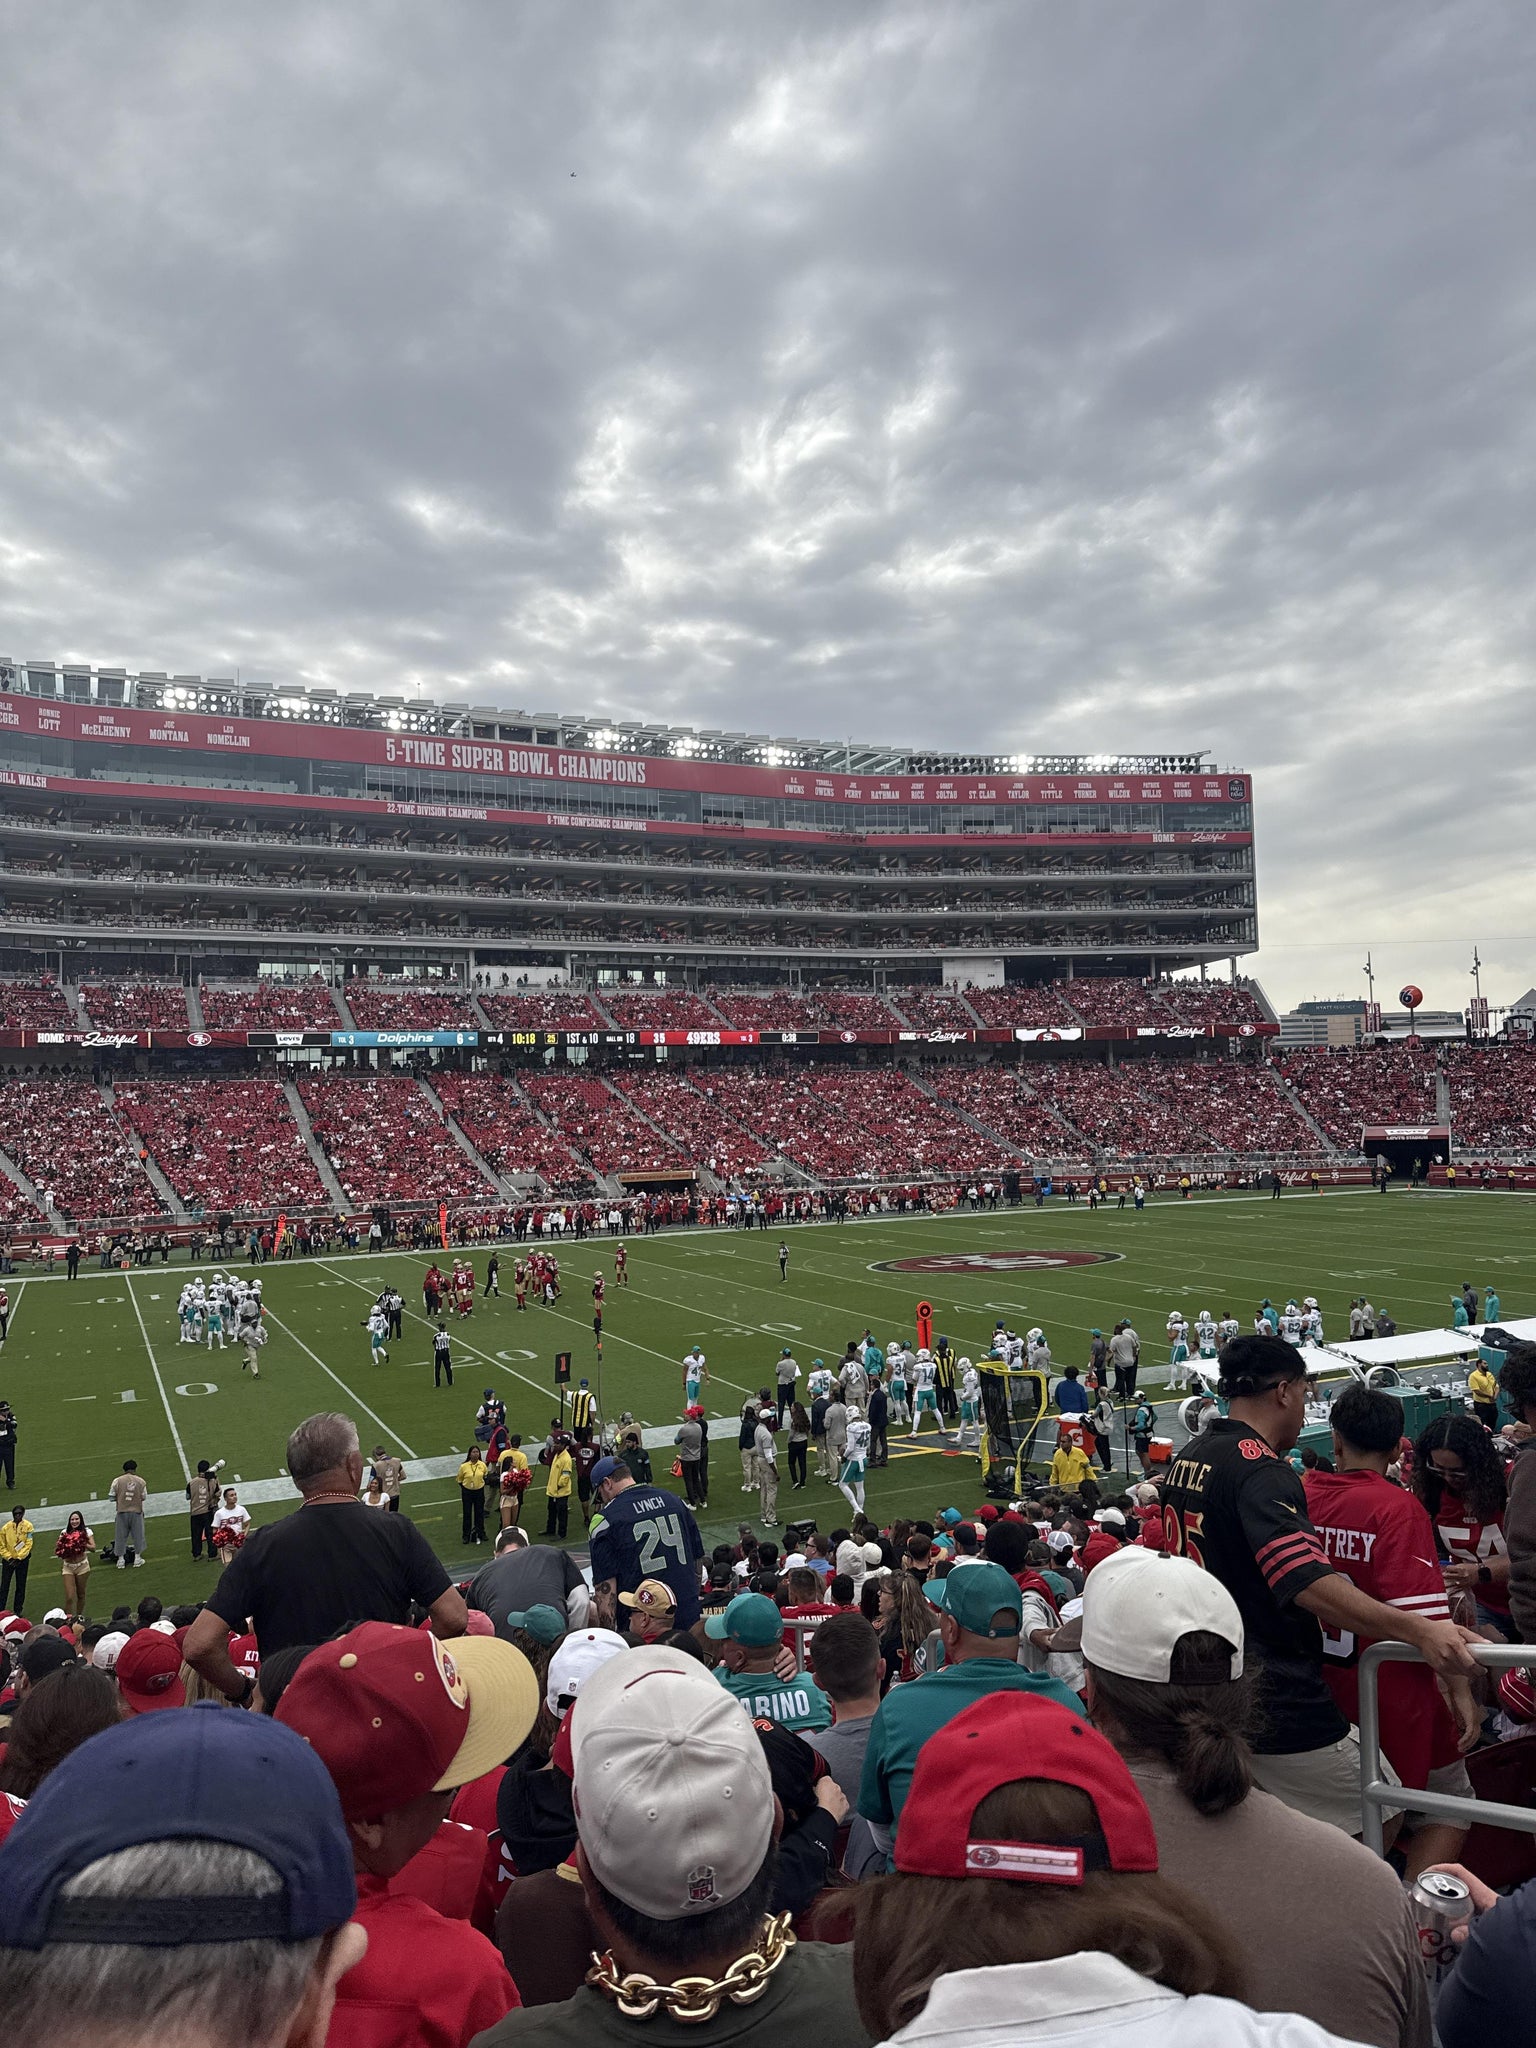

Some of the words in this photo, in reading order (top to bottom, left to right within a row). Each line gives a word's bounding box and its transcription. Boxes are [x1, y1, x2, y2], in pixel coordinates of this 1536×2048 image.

[39, 708, 60, 718] RONNIE
[38, 718, 60, 731] LOTT
[163, 721, 175, 729] JOE
[223, 725, 234, 733] LEO
[81, 723, 131, 738] McELHENNY
[149, 729, 189, 742] MONTANA
[207, 733, 250, 747] NOMELLINI
[386, 738, 445, 766] 5-TIME
[452, 744, 504, 772] SUPER
[509, 750, 553, 776] BOWL
[558, 754, 646, 784] CHAMPIONS
[18, 774, 47, 788] WALSH
[784, 784, 805, 794] OWENS
[815, 786, 834, 797] OWENS
[844, 789, 862, 798] PERRY
[911, 790, 925, 799] RICE
[979, 790, 997, 799] CLAIR
[1008, 790, 1030, 799] TAYLOR
[1041, 790, 1063, 799] TITTLE
[1074, 790, 1097, 798] TURNER
[1108, 790, 1131, 798] WILCOX
[1142, 789, 1162, 798] WILLIS
[1173, 789, 1192, 798] YOUNG
[1203, 789, 1221, 798] YOUNG
[870, 791, 900, 799] RATHMAN
[387, 803, 415, 814] 22-TIME
[416, 805, 447, 817] DIVISION
[448, 807, 487, 820] CHAMPIONS
[547, 814, 570, 826] 8-TIME
[570, 816, 611, 829] CONFERENCE
[611, 818, 647, 832] CHAMPIONS
[1152, 833, 1175, 843] HOME
[899, 1031, 917, 1040] HOME
[927, 1030, 967, 1042] Faithful
[1137, 1028, 1156, 1036] HOME
[1167, 1025, 1206, 1038] Faithful
[37, 1033, 65, 1043] HOME
[81, 1031, 138, 1047] Faithful
[348, 1035, 355, 1045] 3
[376, 1033, 434, 1045] Dolphins
[456, 1033, 464, 1045] 6
[497, 1033, 503, 1045] 4
[512, 1033, 536, 1044] 10:18
[546, 1034, 556, 1043] 25
[566, 1032, 580, 1044] 1ST
[581, 1036, 587, 1044] &
[588, 1032, 599, 1044] 10
[625, 1033, 635, 1044] 18
[653, 1032, 666, 1044] 35
[686, 1031, 721, 1045] 49ERS
[748, 1034, 753, 1043] 3
[781, 1033, 797, 1043] 0:38
[457, 1275, 467, 1285] 47
[1200, 1327, 1214, 1340] 42
[1227, 1326, 1238, 1338] 50
[1287, 1322, 1300, 1334] 62
[560, 1355, 568, 1372] 1
[922, 1367, 935, 1382] 14
[1067, 1428, 1084, 1447] G
[632, 1496, 666, 1514] LYNCH
[632, 1513, 688, 1575] 24
[1437, 1523, 1509, 1564] 54
